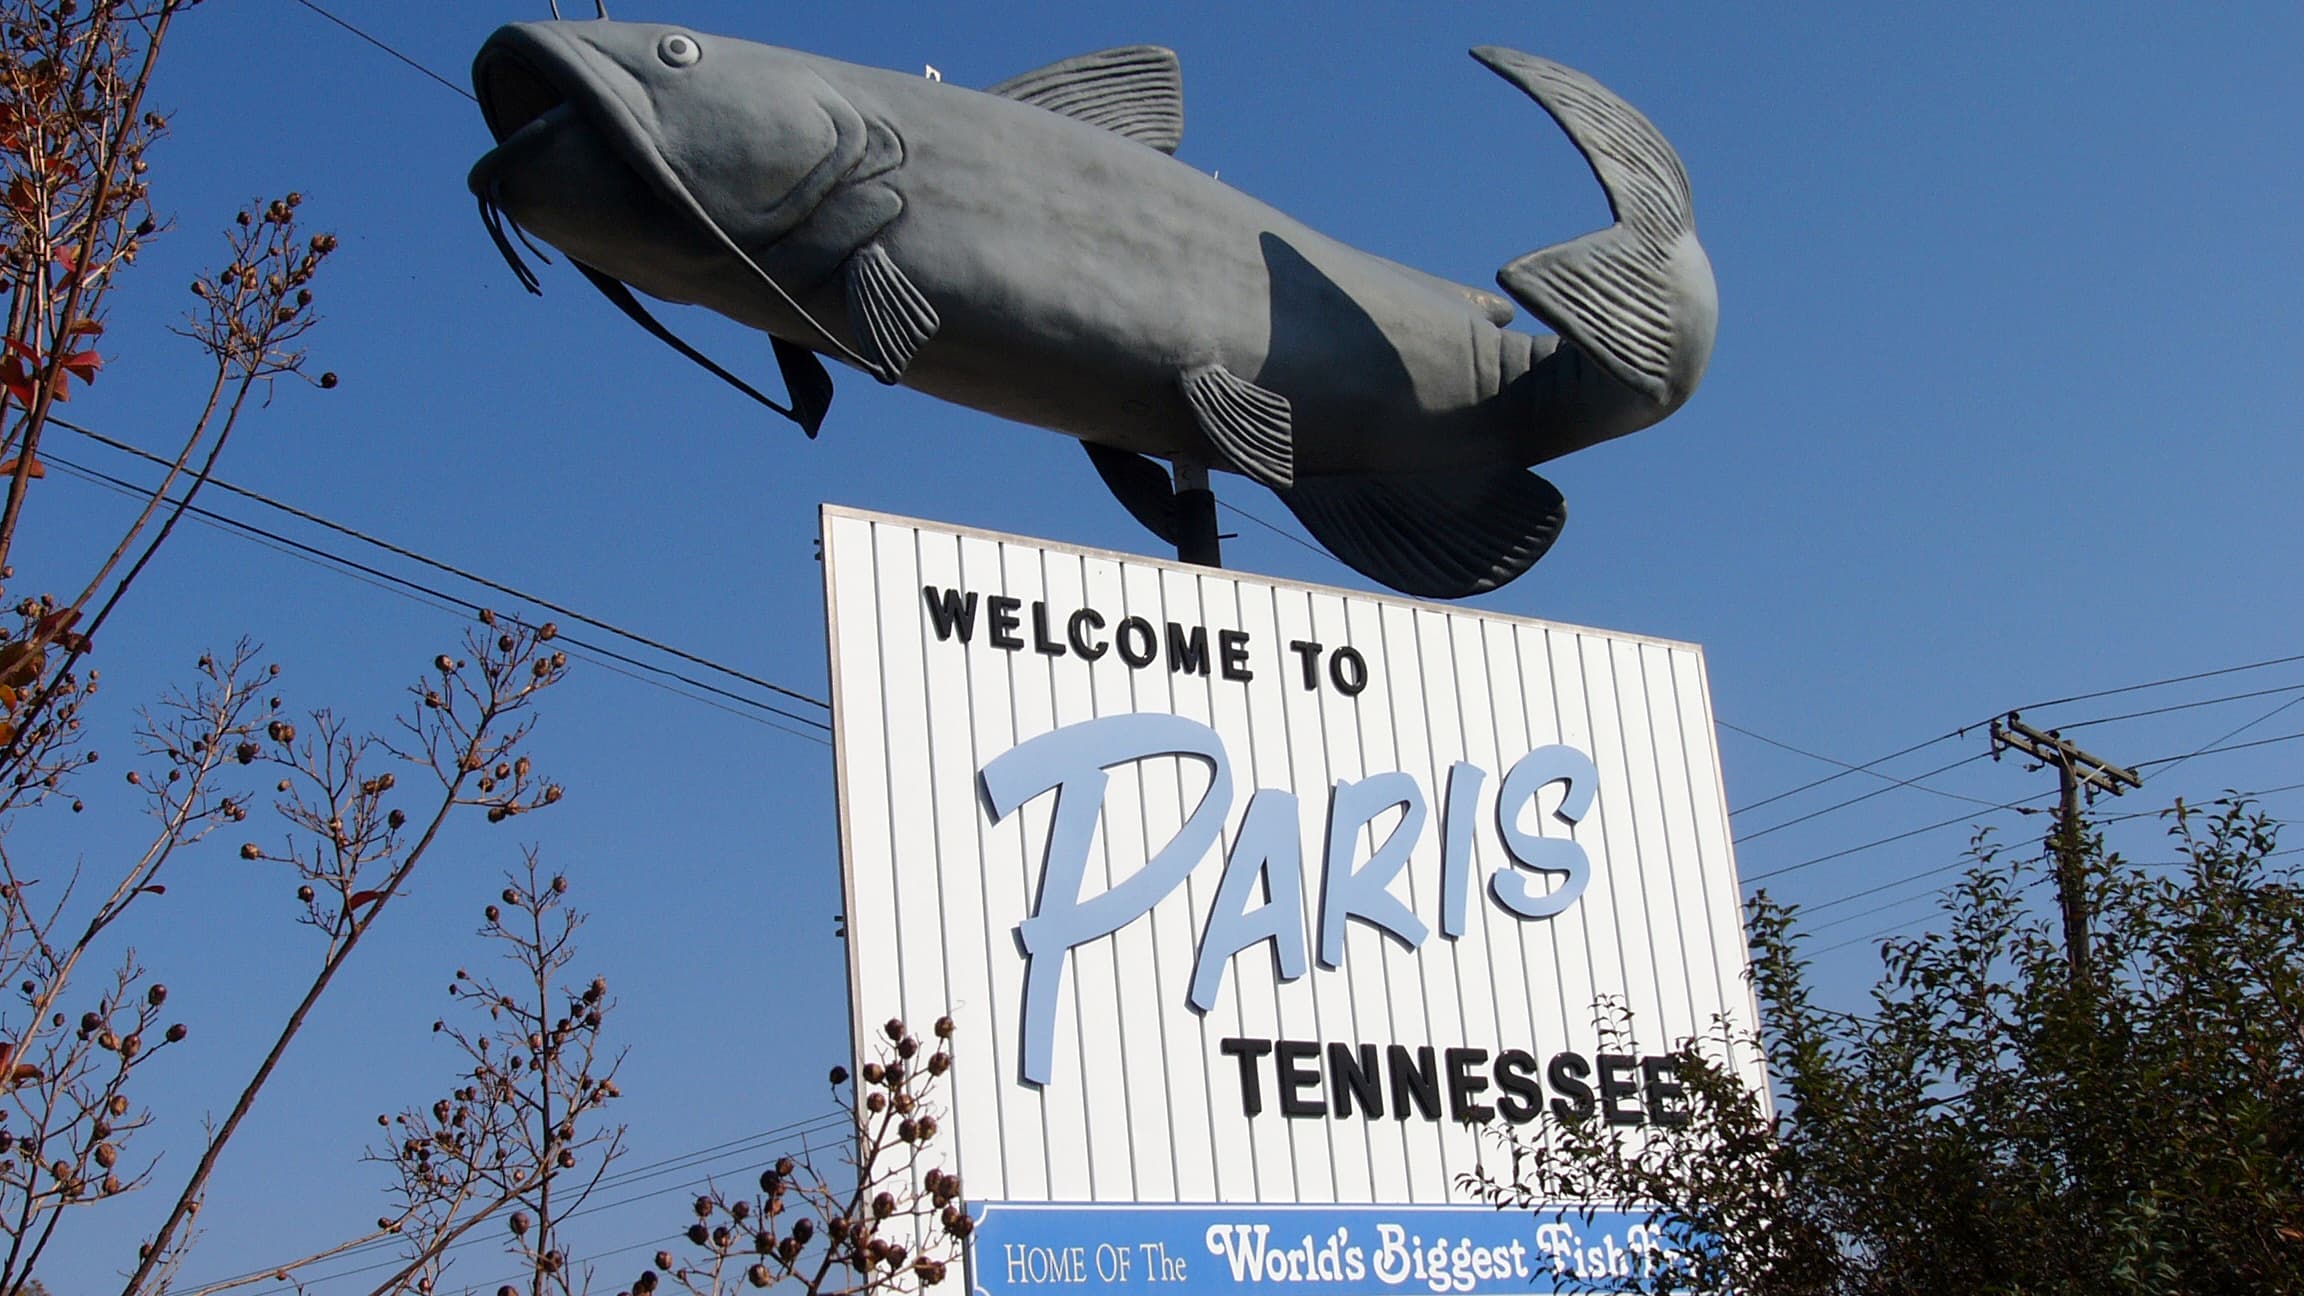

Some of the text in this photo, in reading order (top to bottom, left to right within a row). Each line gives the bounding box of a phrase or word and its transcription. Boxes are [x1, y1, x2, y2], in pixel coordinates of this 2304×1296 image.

[923, 585, 1368, 697] WELCOME TO
[978, 712, 1600, 1086] PARIS
[1221, 1038, 1690, 1126] TENNESSEE
[1003, 1243, 1088, 1284] HOME
[1096, 1242, 1132, 1283] OF
[1140, 1241, 1188, 1283] The
[1205, 1223, 1366, 1283] World's
[1373, 1223, 1529, 1293] Biggest
[1536, 1222, 1630, 1280] Fish
